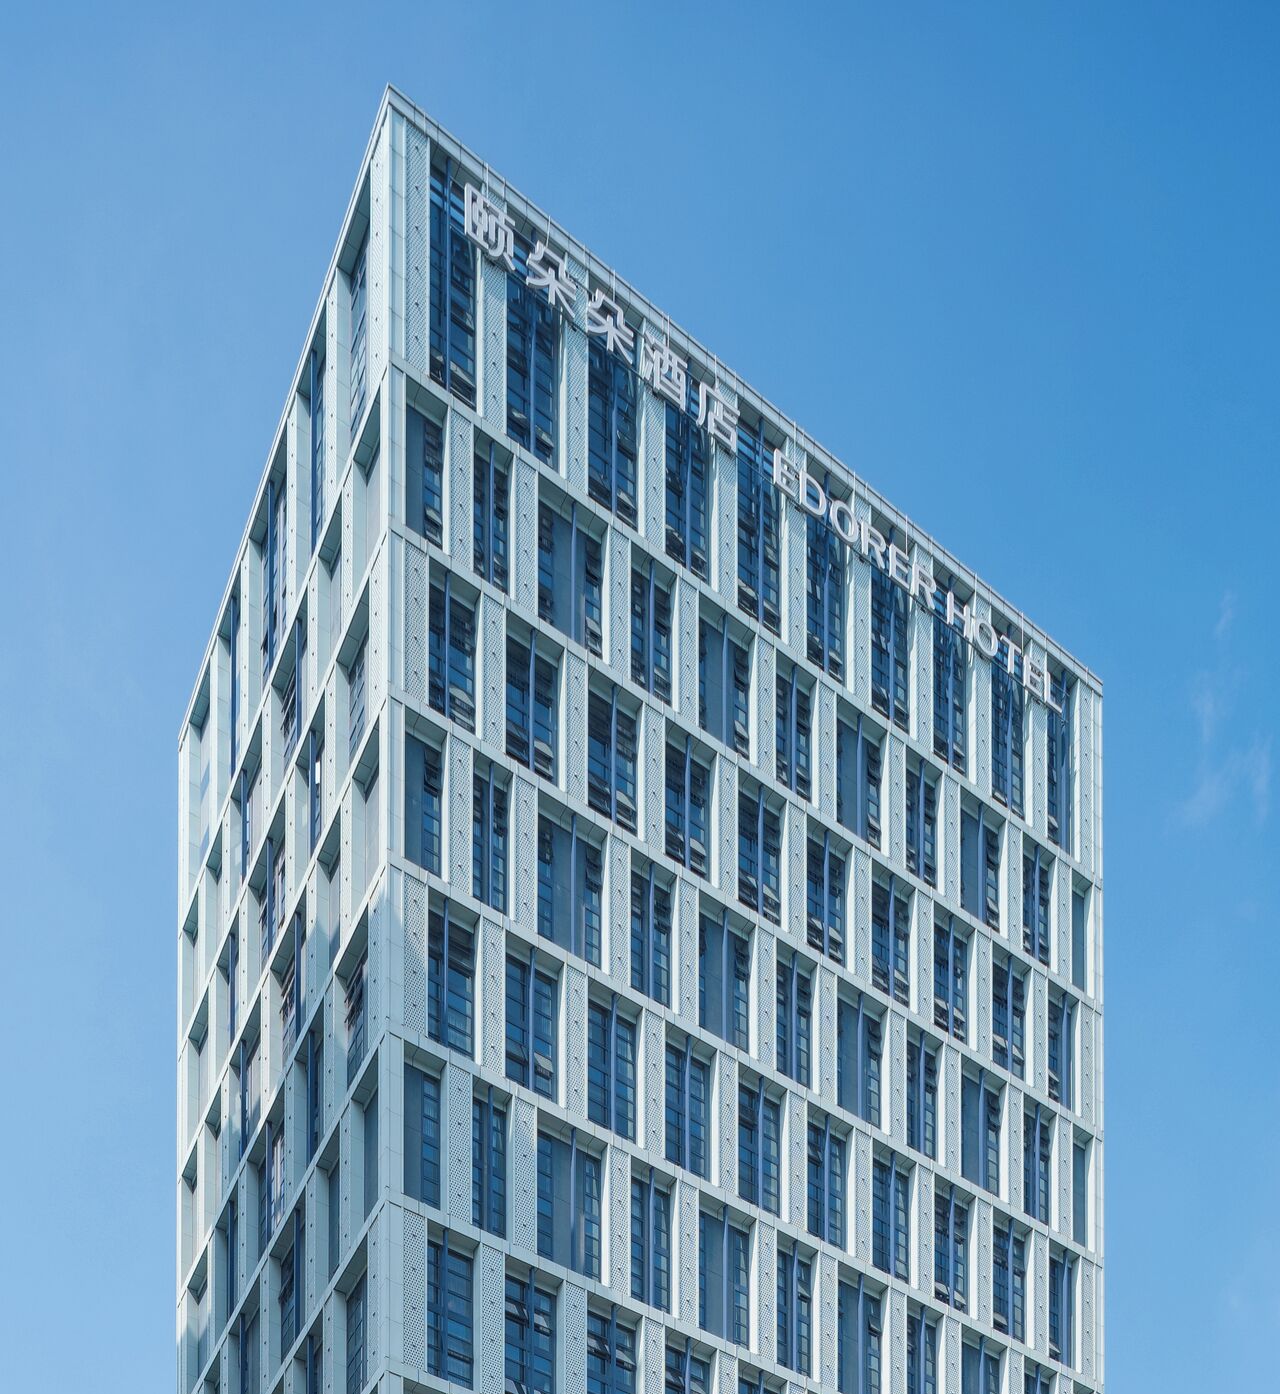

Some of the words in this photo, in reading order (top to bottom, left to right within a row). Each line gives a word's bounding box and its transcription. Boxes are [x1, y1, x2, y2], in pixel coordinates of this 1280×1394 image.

[464, 182, 740, 453] 颐朵朵酒店
[773, 448, 936, 610] EDORER
[947, 591, 1062, 714] HOTEL
